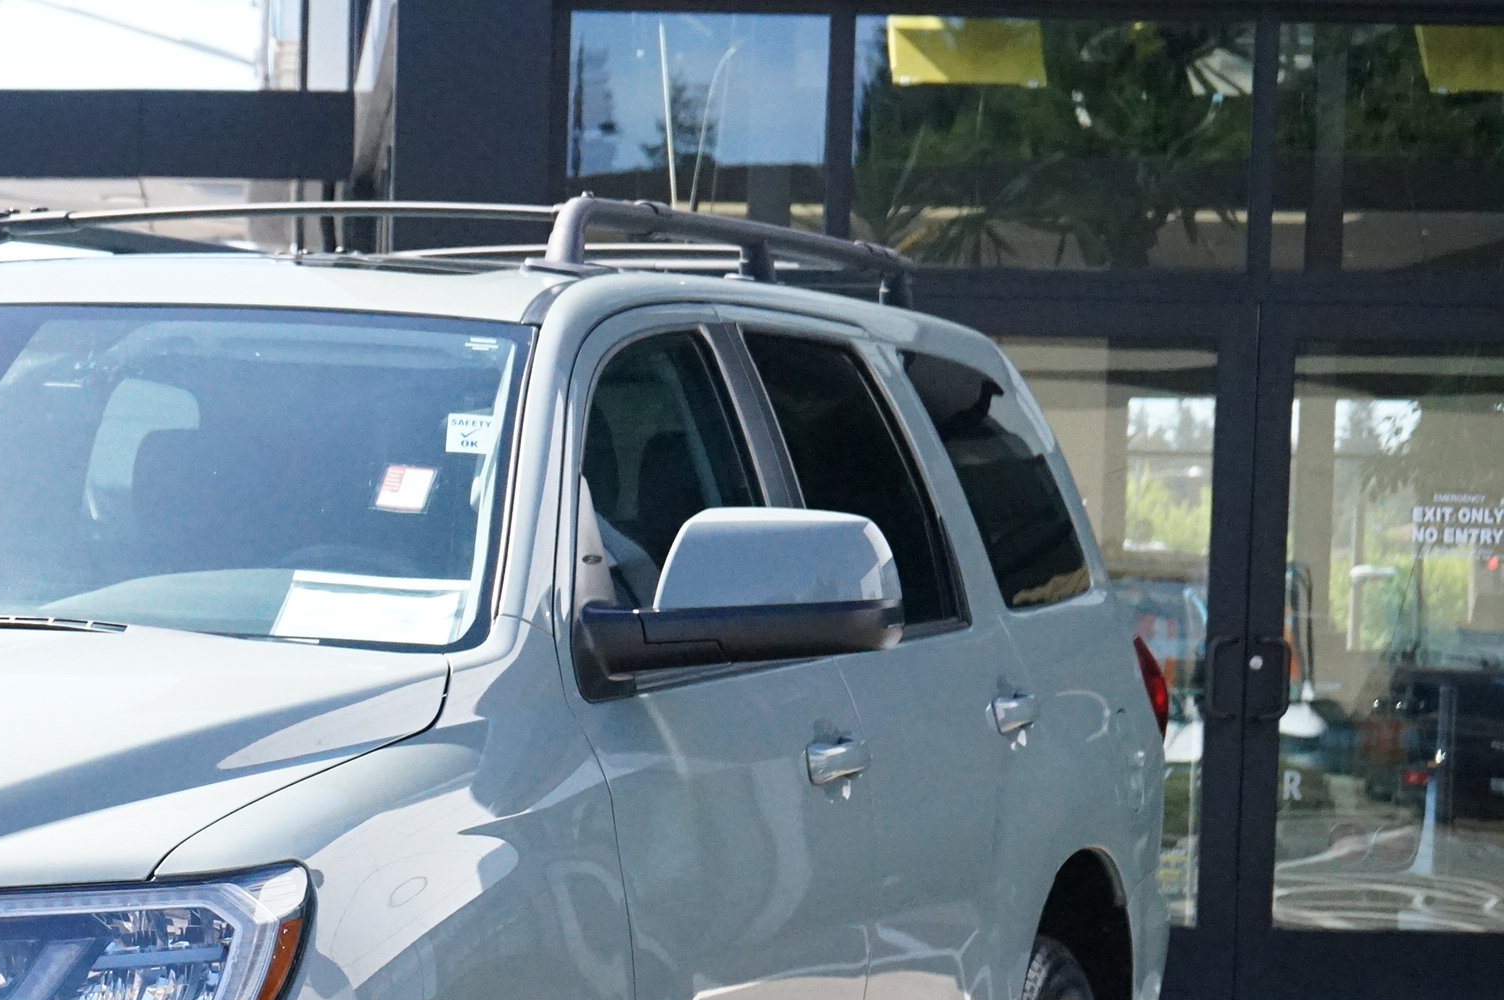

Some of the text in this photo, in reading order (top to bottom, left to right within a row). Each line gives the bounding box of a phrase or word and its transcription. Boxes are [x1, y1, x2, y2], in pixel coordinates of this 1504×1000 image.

[451, 418, 492, 428] SAFETY
[460, 440, 478, 448] OK
[1412, 506, 1504, 524] EXIT ONLY
[1412, 526, 1504, 544] NO ENTRY
